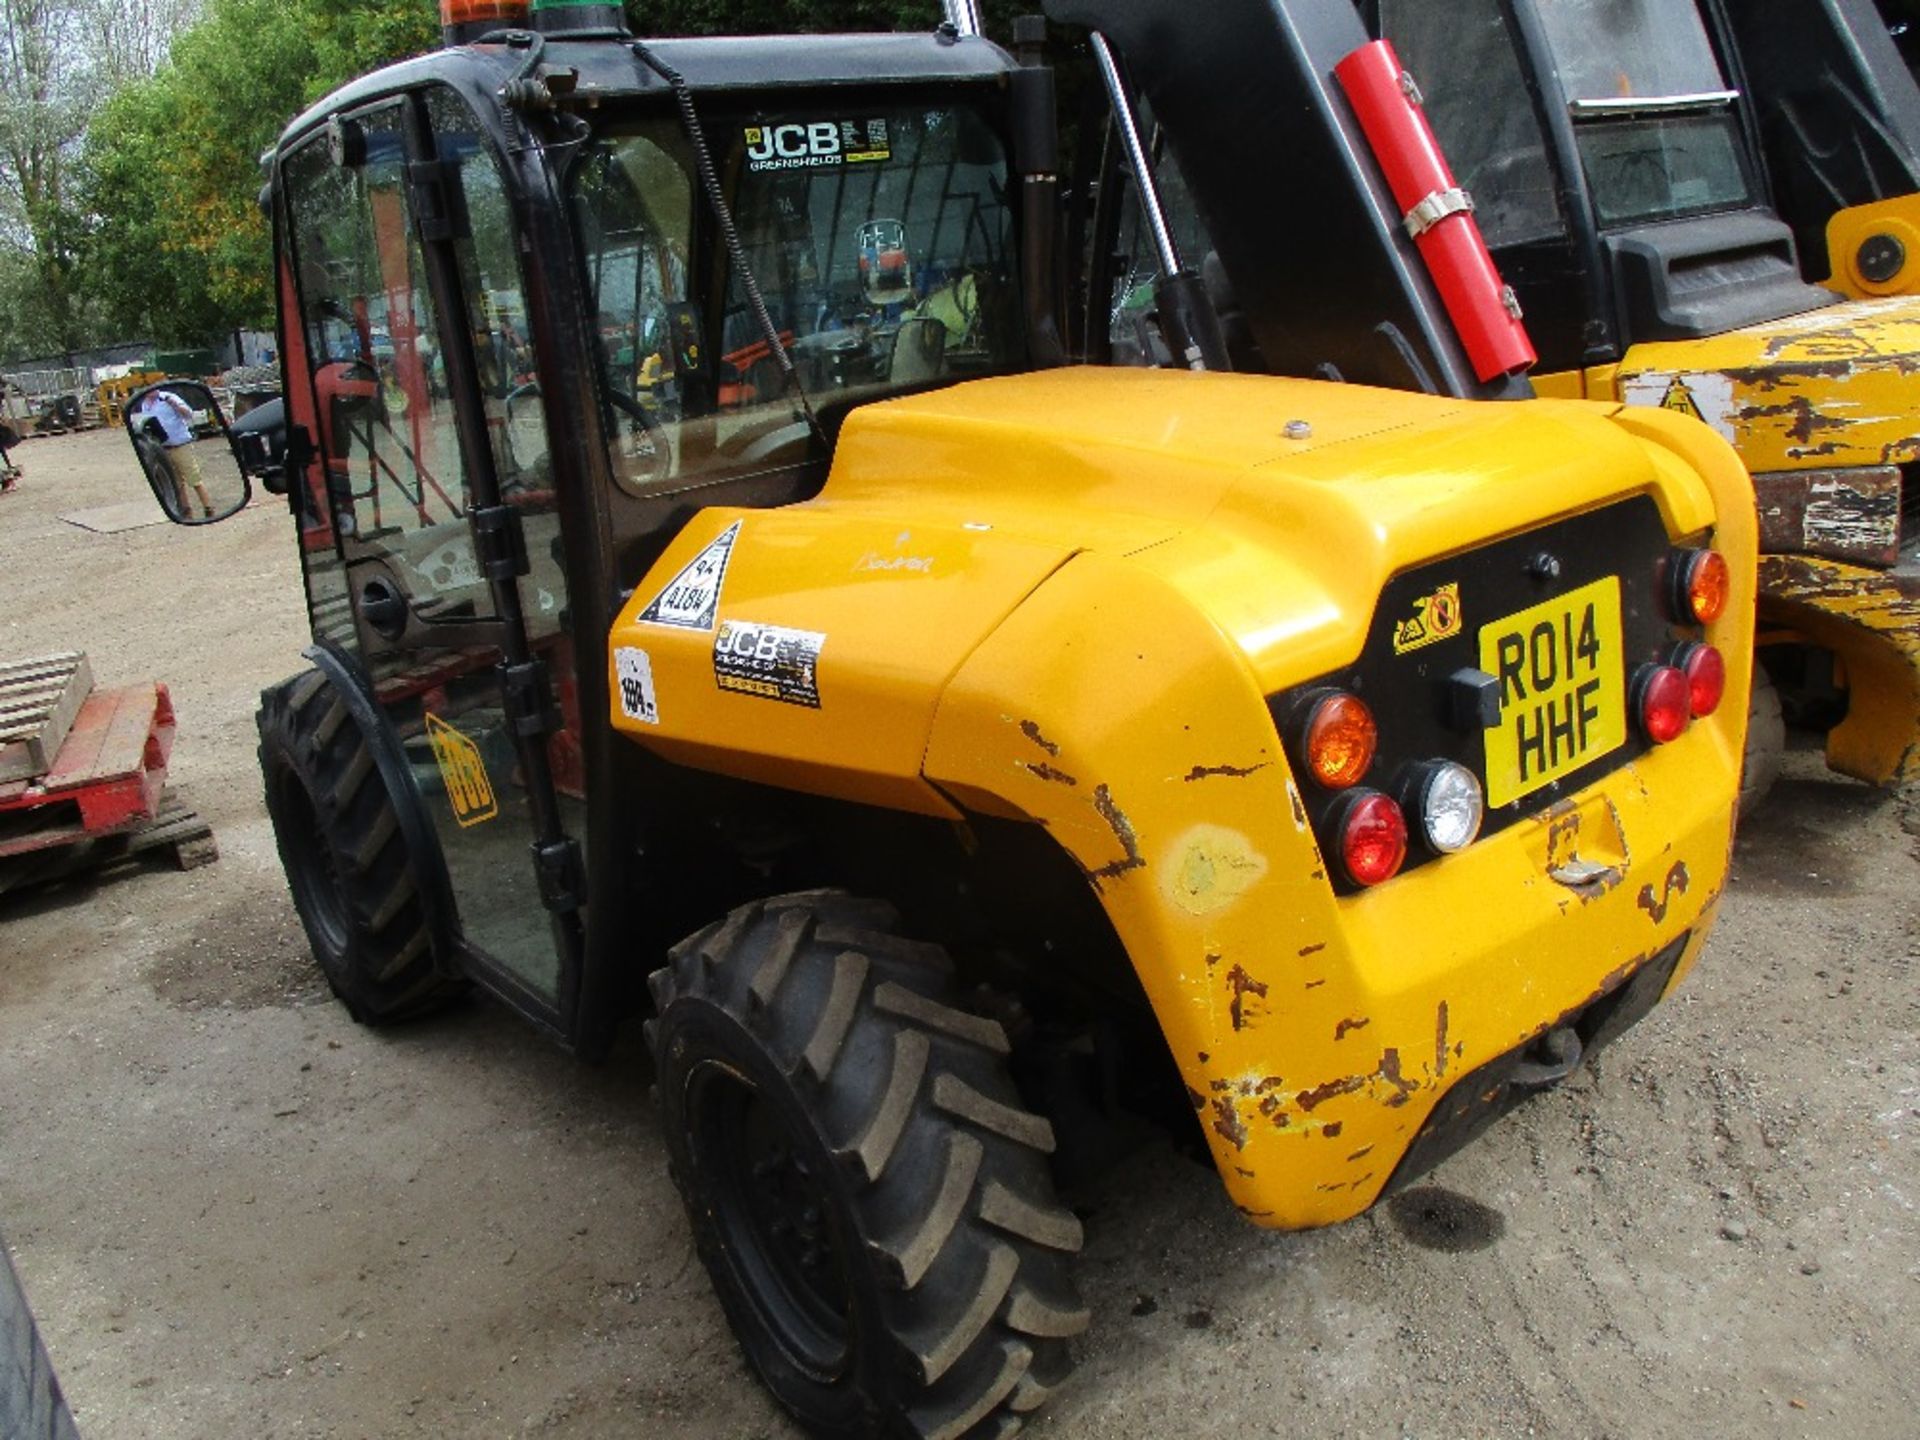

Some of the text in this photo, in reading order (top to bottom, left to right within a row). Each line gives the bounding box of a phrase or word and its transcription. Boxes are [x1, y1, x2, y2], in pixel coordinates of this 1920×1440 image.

[748, 122, 840, 160] JCB
[716, 626, 778, 660] JCB
[1498, 603, 1599, 708] RO14
[1517, 678, 1599, 783] HHF
